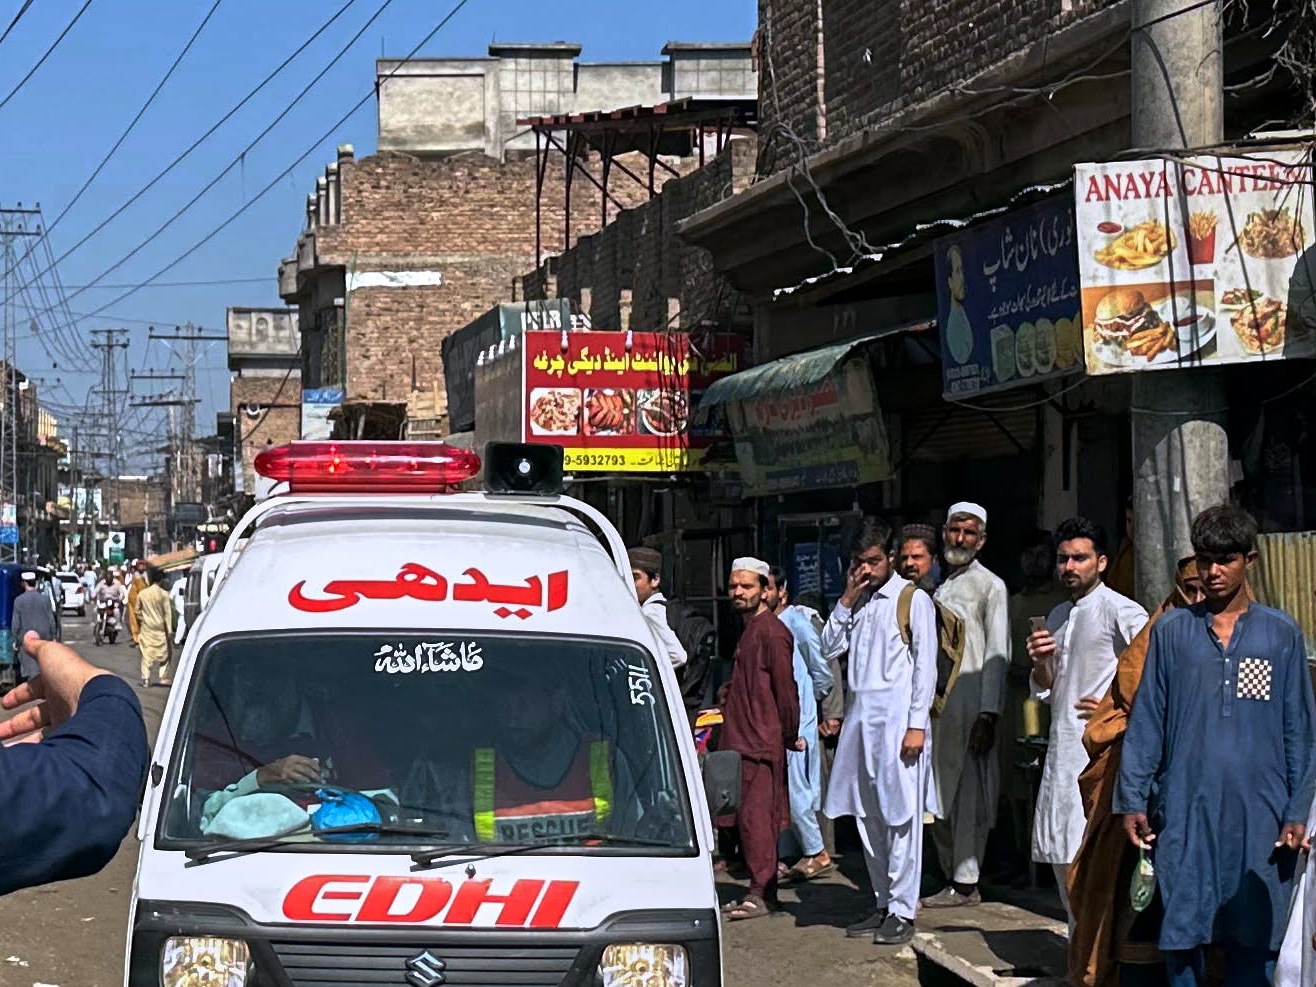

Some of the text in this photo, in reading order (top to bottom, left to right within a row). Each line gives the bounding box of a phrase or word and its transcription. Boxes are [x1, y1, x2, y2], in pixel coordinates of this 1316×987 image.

[1085, 169, 1173, 203] ANAYA
[533, 349, 566, 379] چرغہ
[567, 345, 602, 376] دیگی
[603, 346, 630, 376] اینڈ
[564, 454, 626, 466] 9-5932793
[288, 562, 569, 620] ایدھی
[282, 874, 580, 928] EDHI
